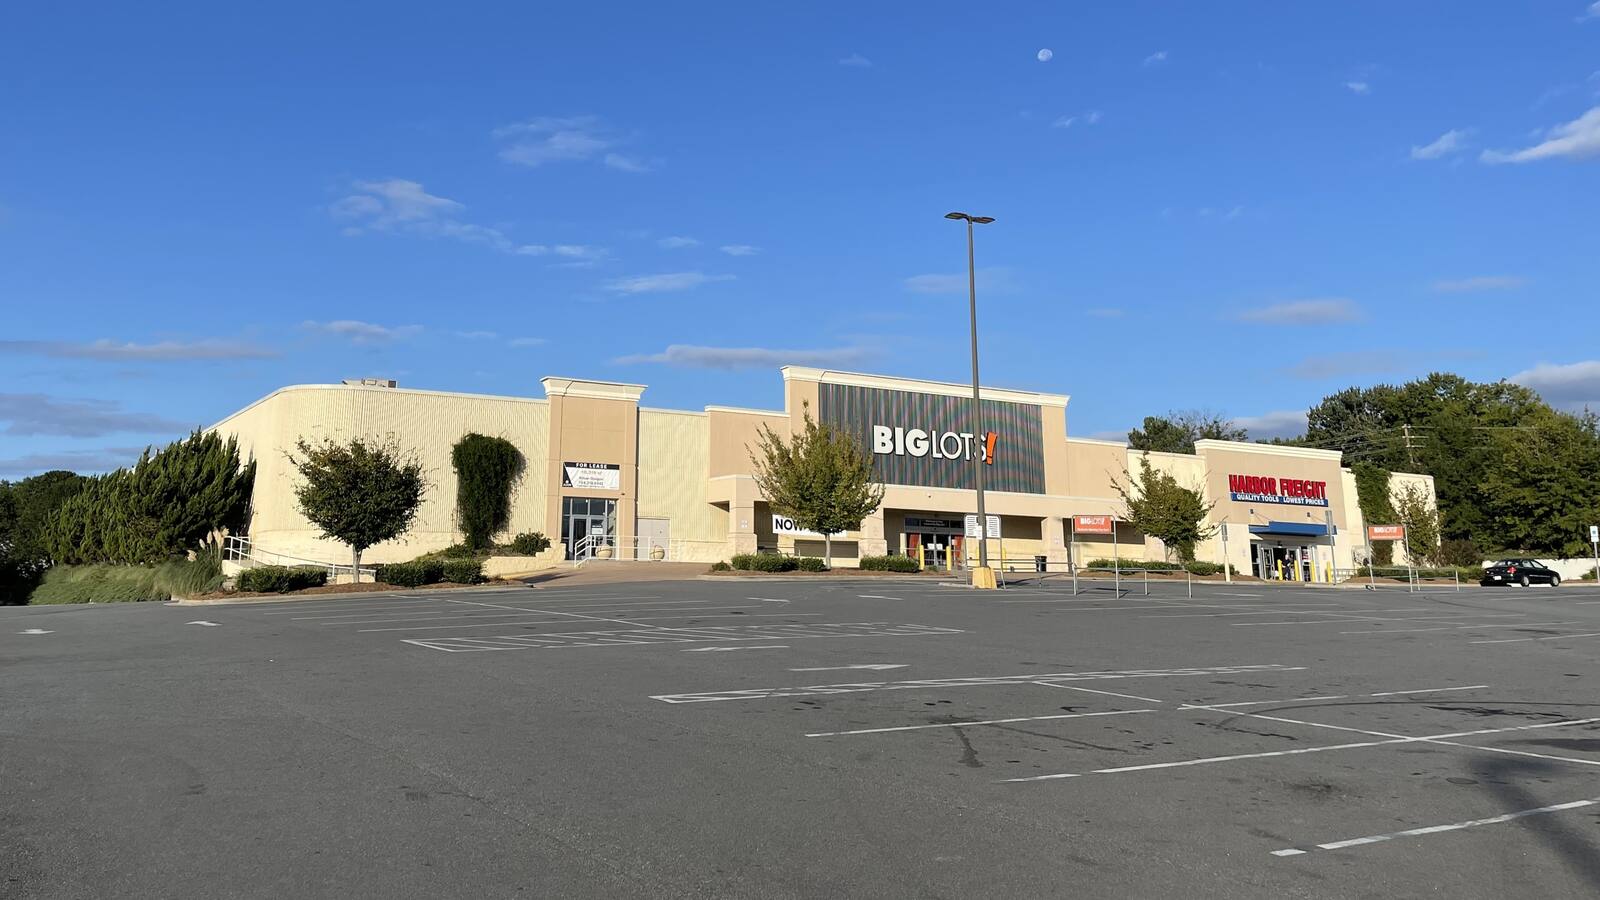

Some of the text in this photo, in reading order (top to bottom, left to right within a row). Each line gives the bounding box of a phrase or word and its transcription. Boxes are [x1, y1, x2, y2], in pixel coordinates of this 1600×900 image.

[1228, 474, 1326, 499] HARBOR FREIGHT
[1236, 493, 1325, 506] QUALITY TOOLS LOWEST PRICES
